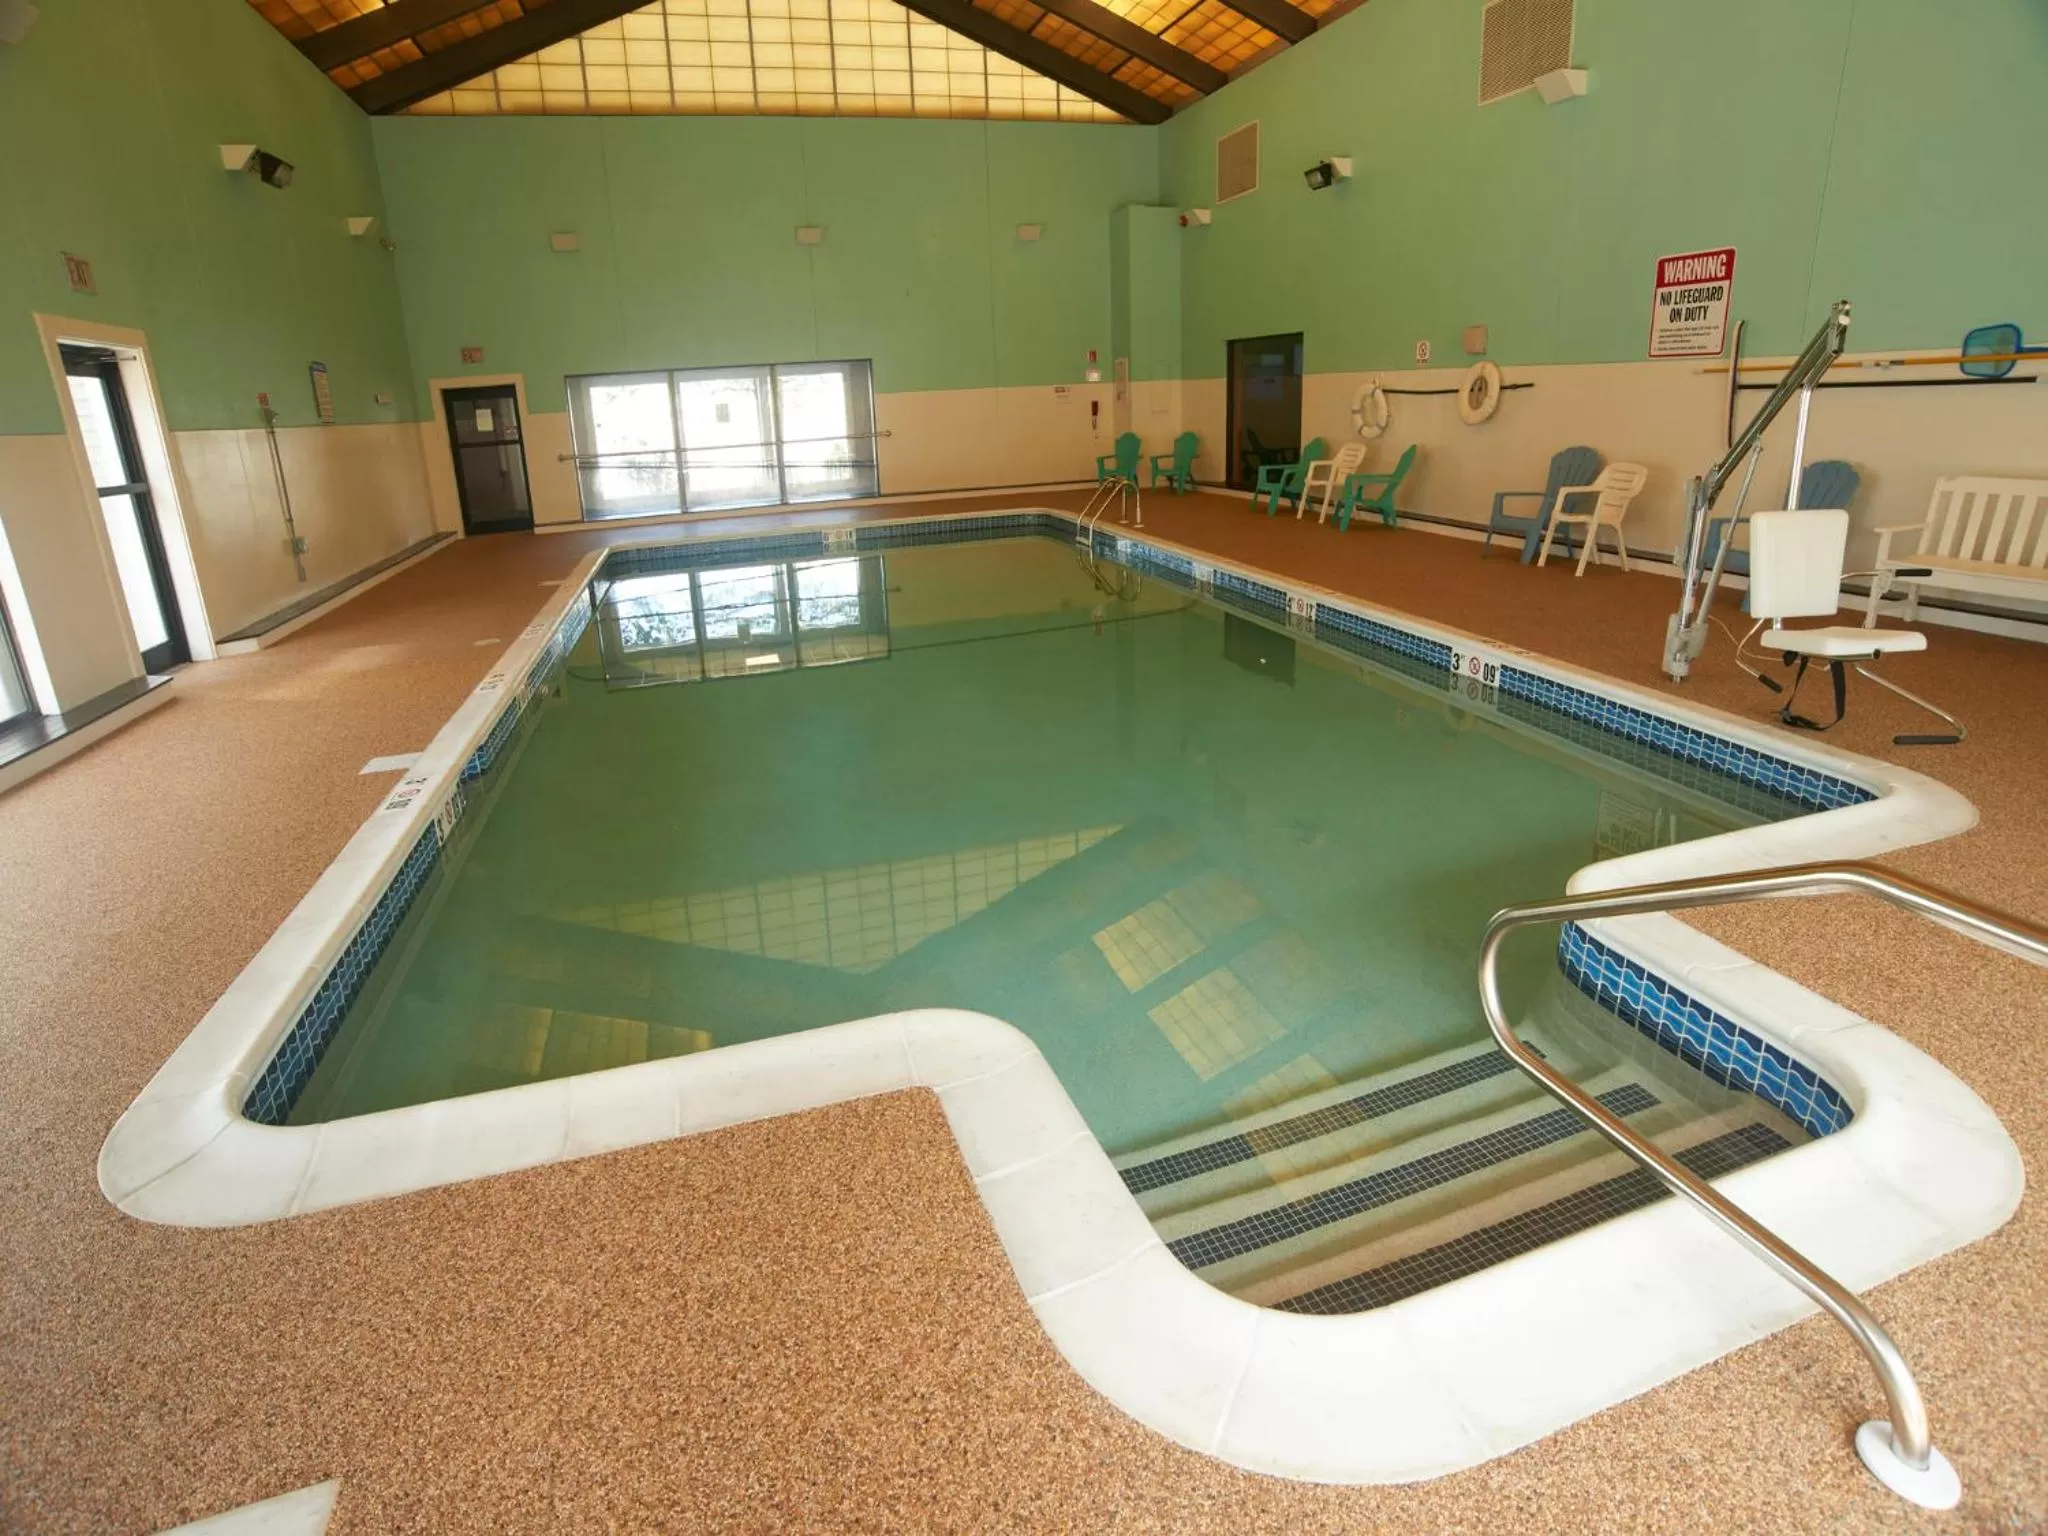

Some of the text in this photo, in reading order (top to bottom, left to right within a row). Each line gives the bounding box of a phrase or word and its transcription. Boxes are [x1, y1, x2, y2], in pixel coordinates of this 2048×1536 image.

[1663, 253, 1727, 284] WARNING
[1660, 286, 1724, 306] NO LIFEGUARD
[1669, 305, 1709, 323] ON DUTY
[1452, 653, 1460, 670] 3
[1483, 663, 1496, 683] 09
